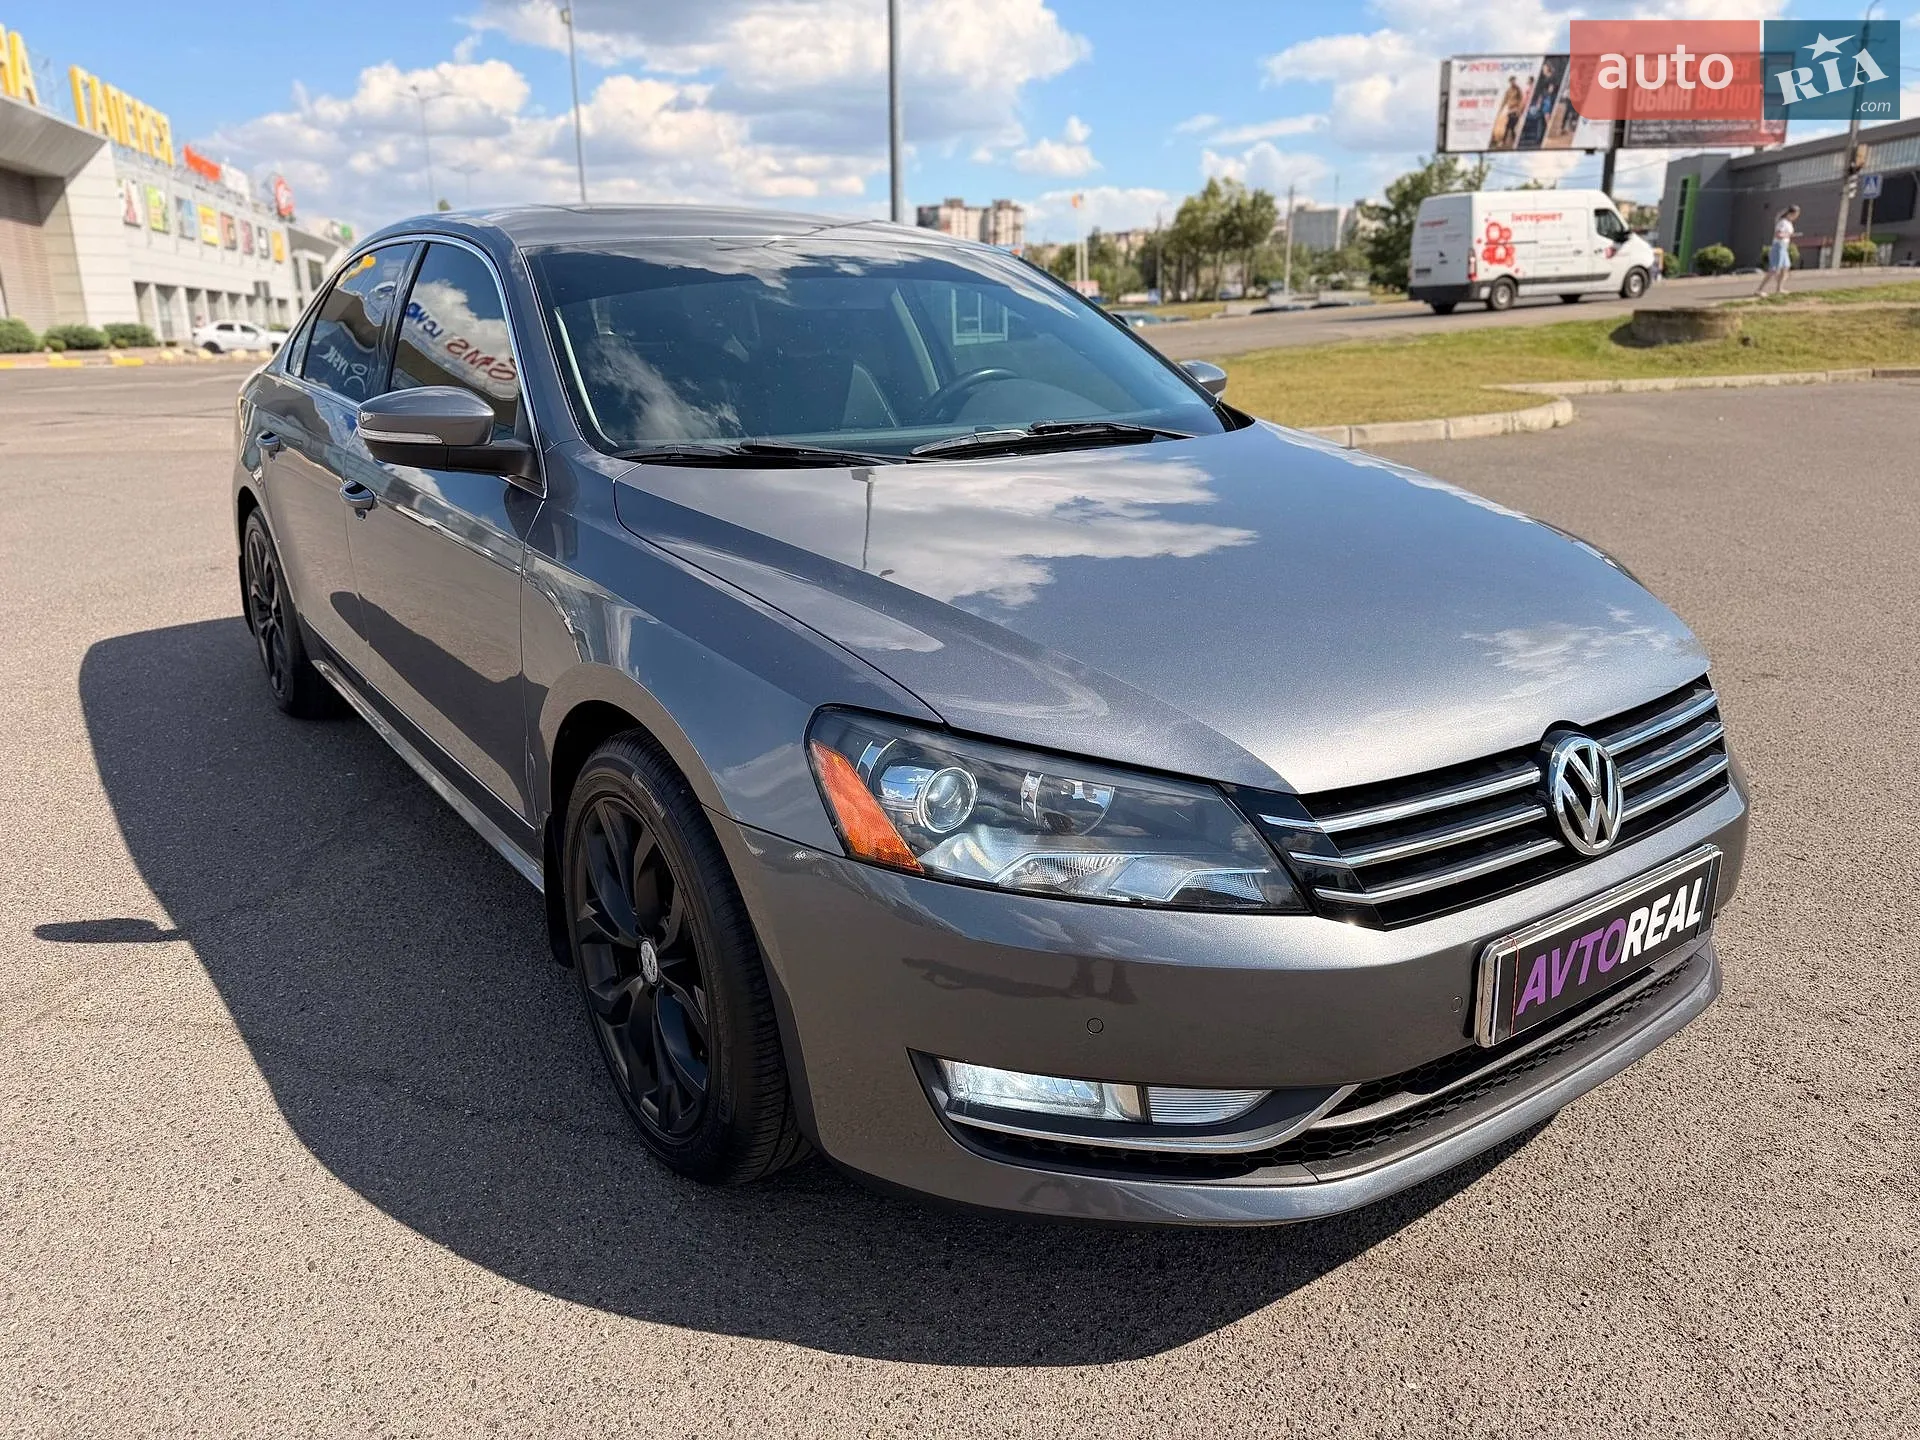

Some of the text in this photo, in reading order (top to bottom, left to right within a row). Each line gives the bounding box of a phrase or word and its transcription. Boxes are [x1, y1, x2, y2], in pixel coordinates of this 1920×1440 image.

[68, 65, 175, 167] ГАЛЕРЕЯ
[1468, 61, 1533, 73] INTERSPORT
[1515, 876, 1704, 1016] AVTOREAL
